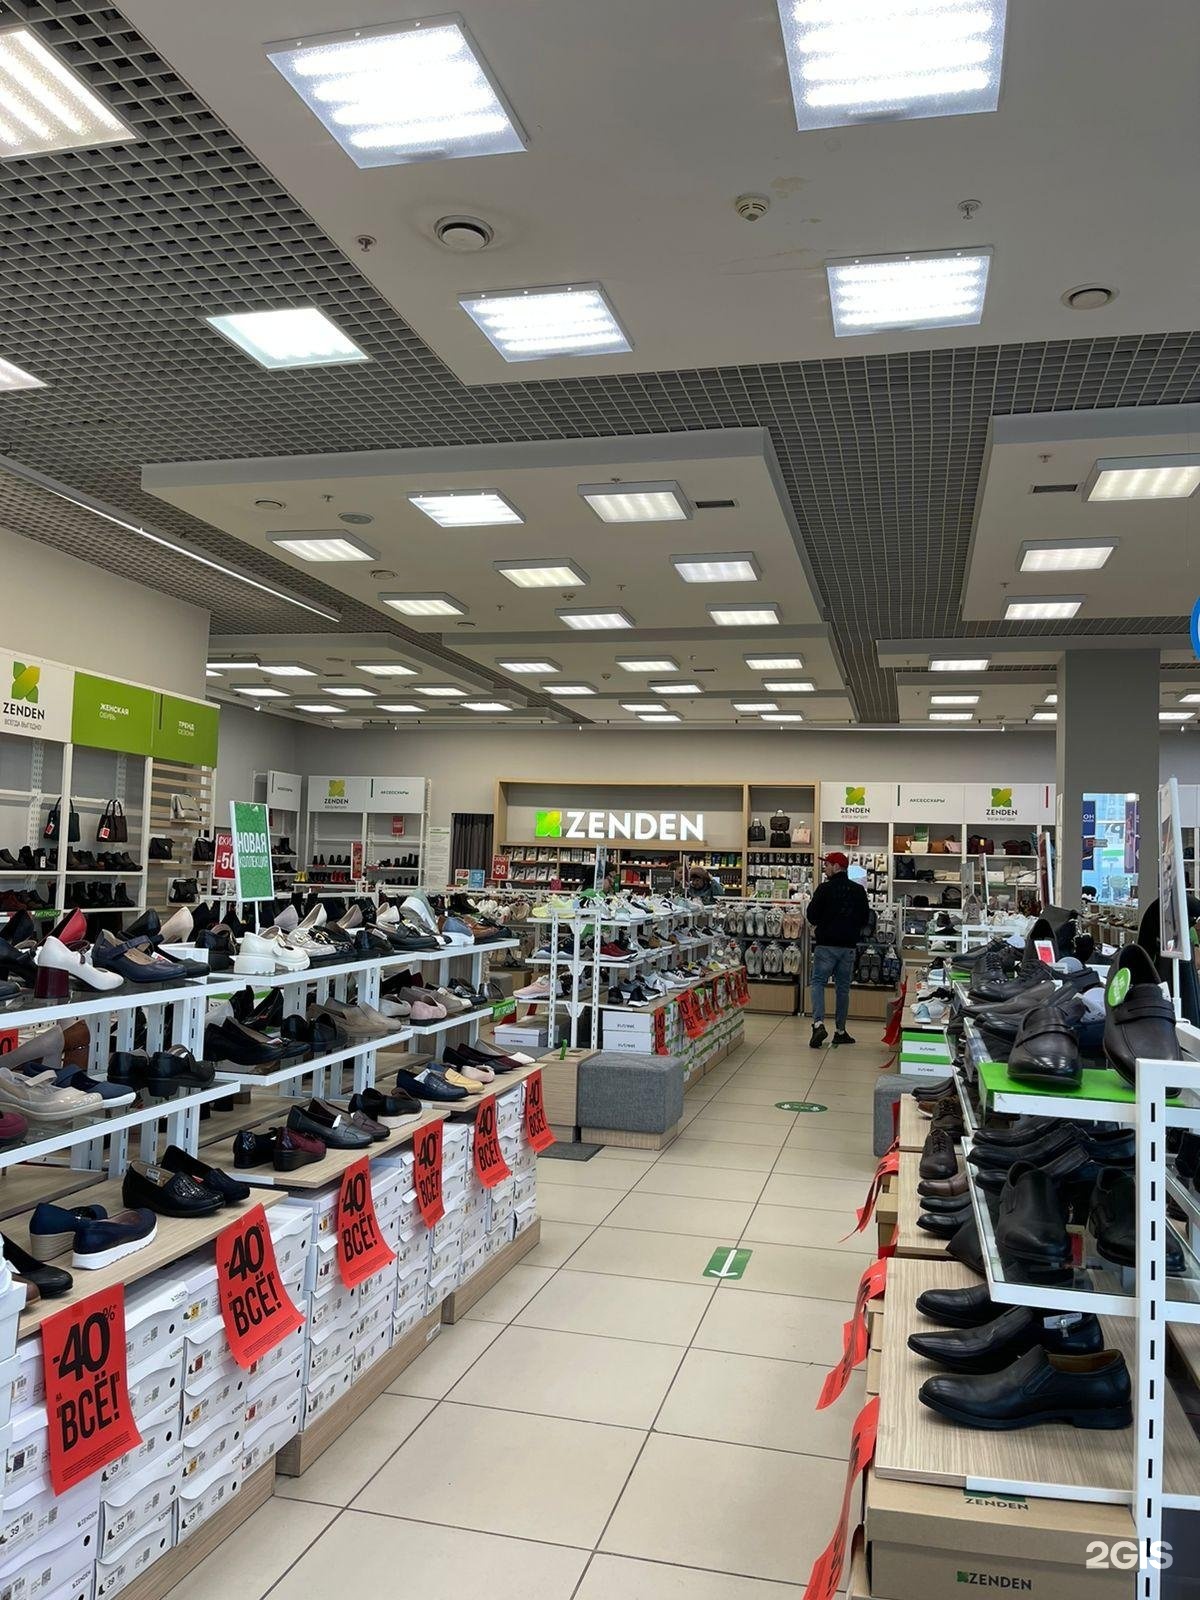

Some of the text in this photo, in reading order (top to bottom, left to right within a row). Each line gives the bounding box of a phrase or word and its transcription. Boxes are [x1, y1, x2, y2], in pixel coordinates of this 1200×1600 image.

[3, 702, 45, 720] ZENDEN
[100, 703, 129, 716] ЖЕНСКАЯ
[566, 811, 704, 841] ZENDEN
[237, 832, 267, 853] НОВАЯ
[341, 1212, 378, 1263] ВСЁ!
[229, 1271, 282, 1338] ВСЁ!
[60, 1371, 120, 1453] ВСЁ!
[965, 1498, 1029, 1511] ZENDEN
[10, 1525, 20, 1538] 39
[116, 1522, 125, 1534] 39
[969, 1572, 1032, 1591] ZENDEN
